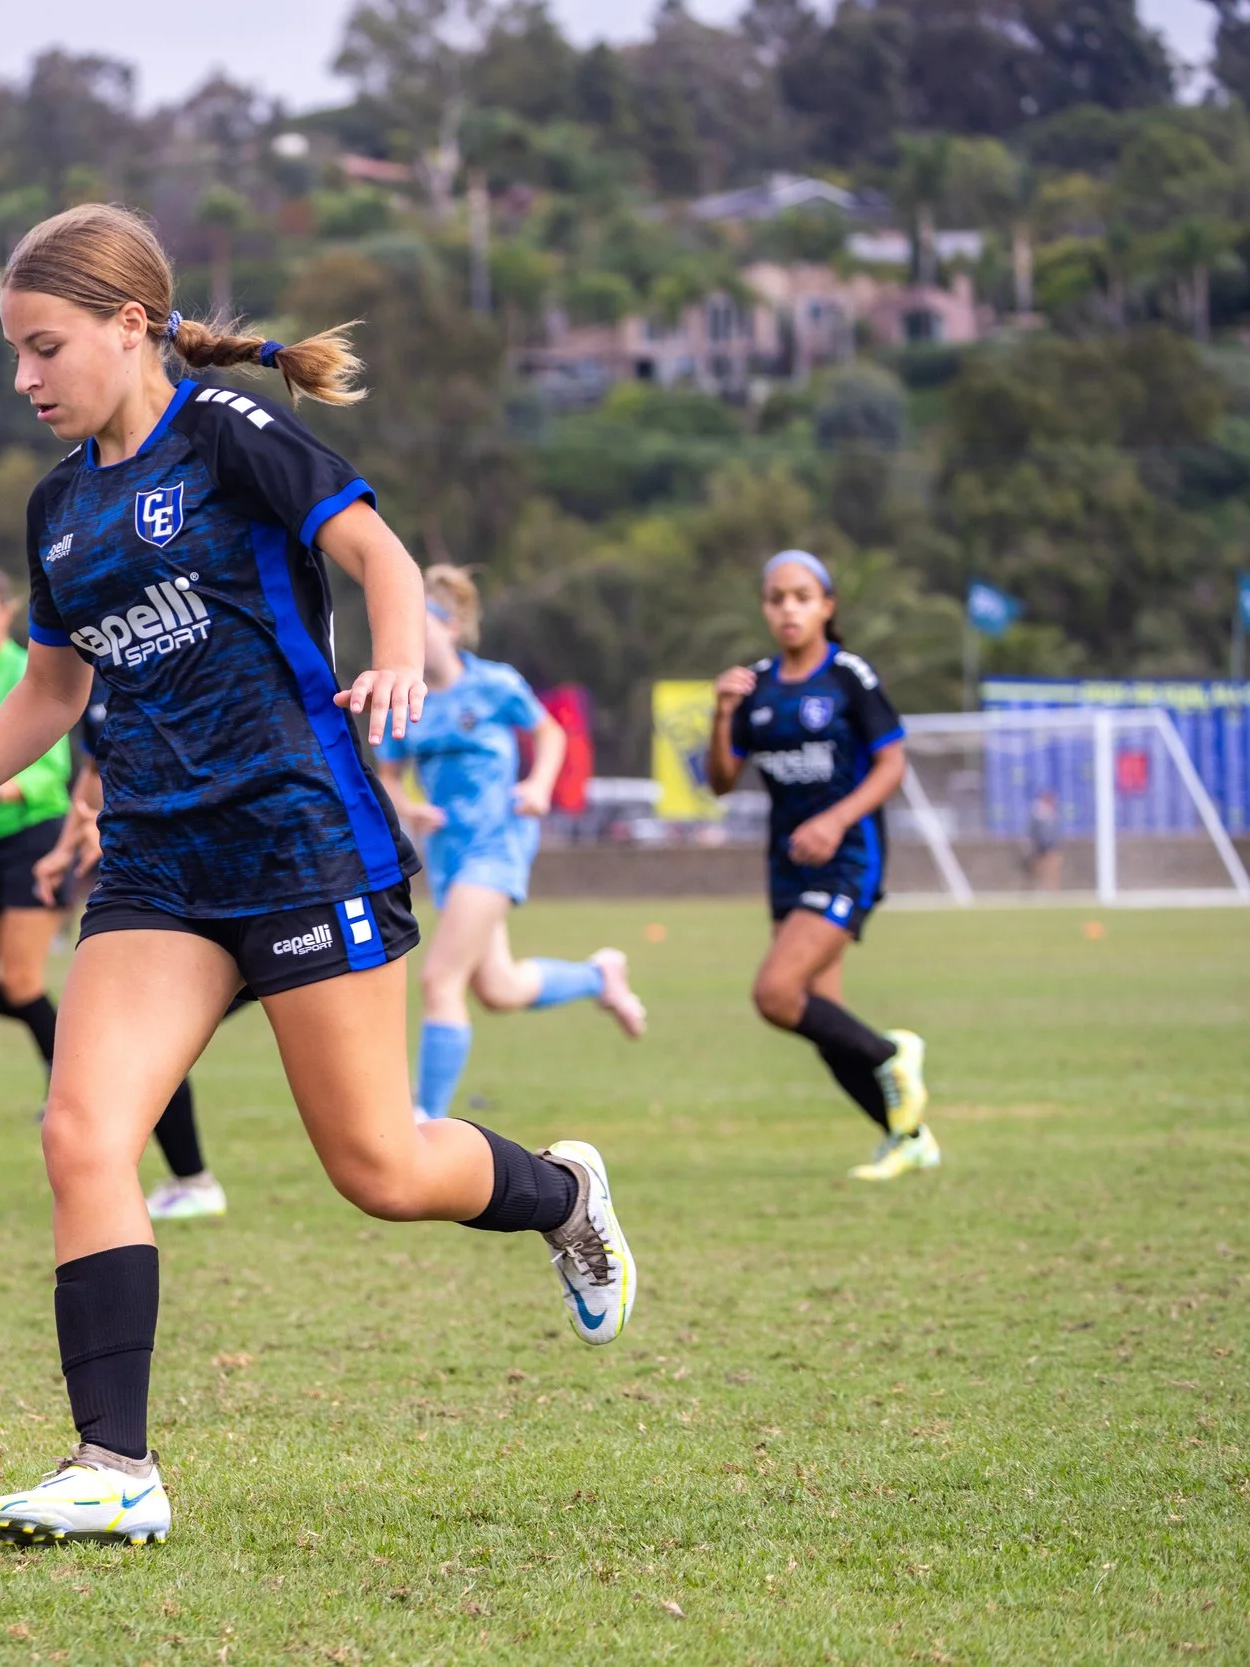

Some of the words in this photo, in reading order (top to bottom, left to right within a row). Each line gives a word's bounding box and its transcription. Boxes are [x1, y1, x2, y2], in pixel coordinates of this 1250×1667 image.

[143, 494, 173, 537] CE
[46, 533, 74, 560] pelli
[125, 619, 211, 667] SPORT
[273, 924, 332, 955] capelli
[298, 940, 333, 955] SPORT
